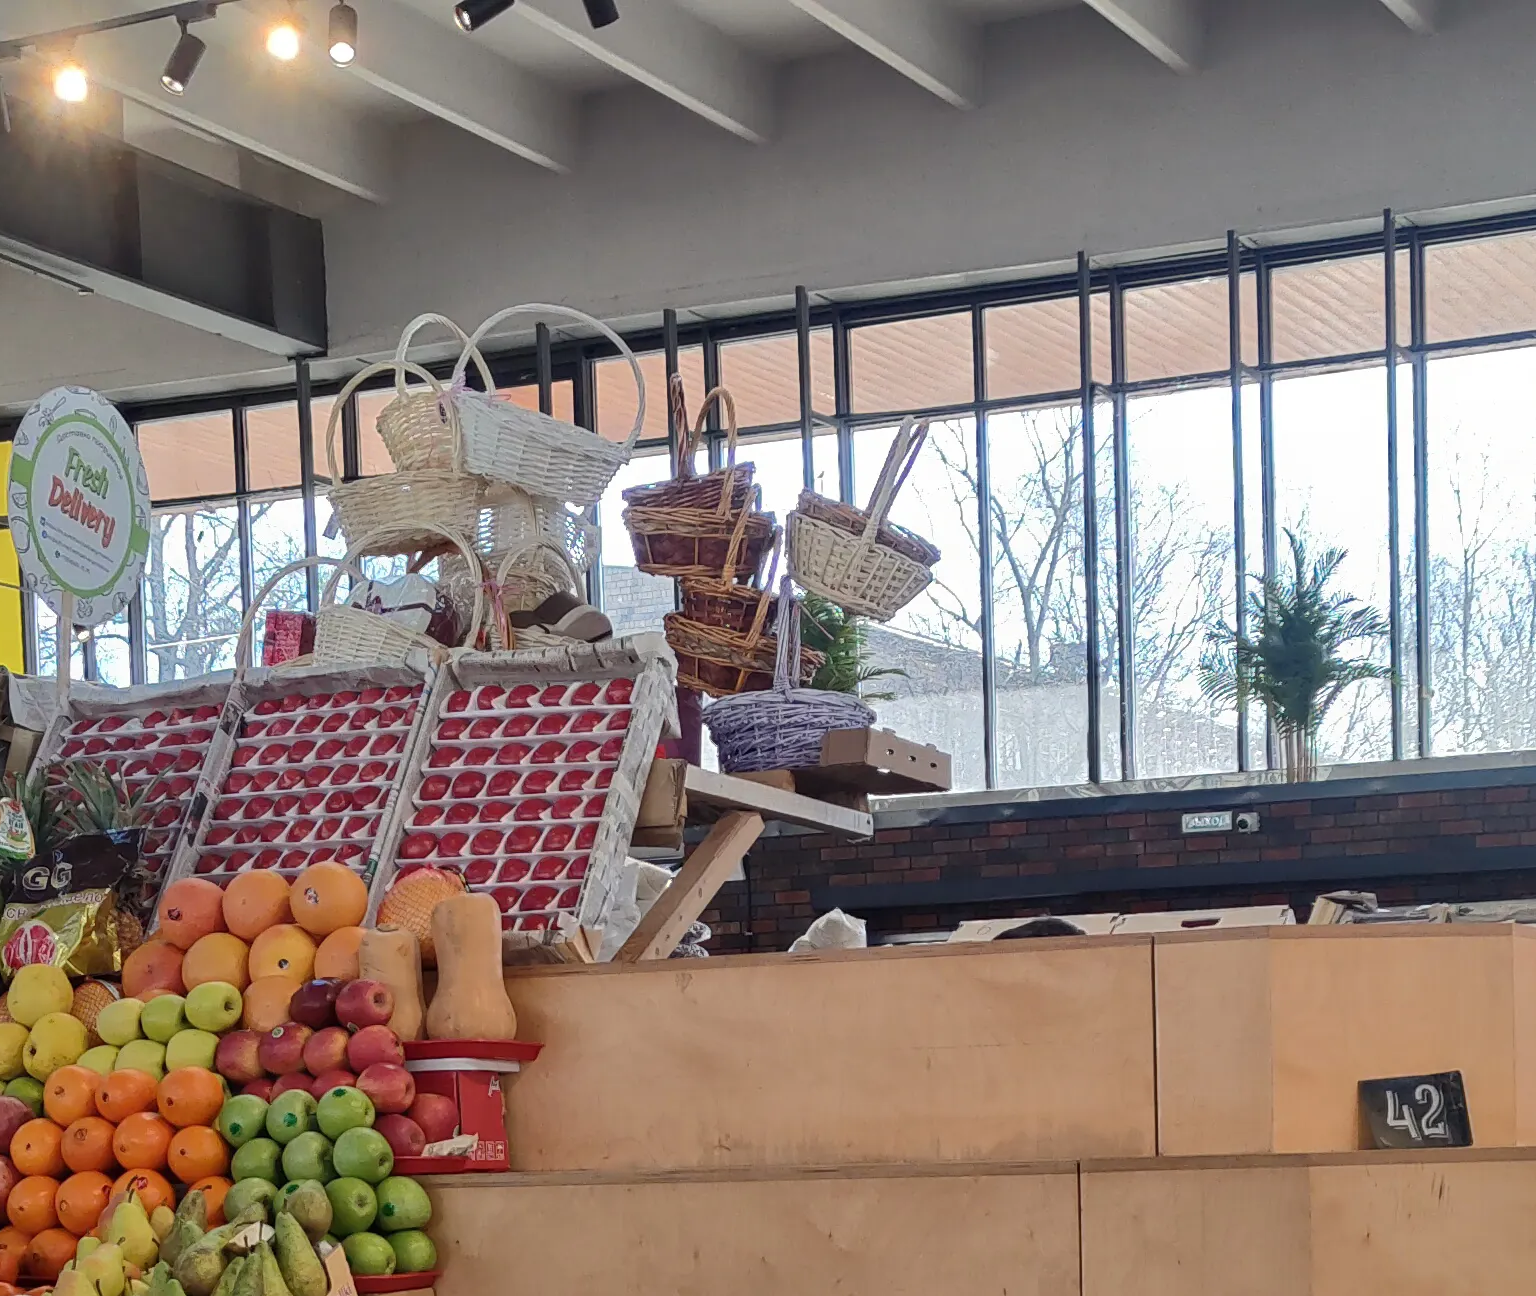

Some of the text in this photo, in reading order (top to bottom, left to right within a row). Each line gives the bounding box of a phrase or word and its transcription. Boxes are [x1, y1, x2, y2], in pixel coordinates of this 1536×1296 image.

[64, 446, 110, 500] Fresh
[48, 474, 116, 549] Delivery
[1385, 1083, 1449, 1141] 42
